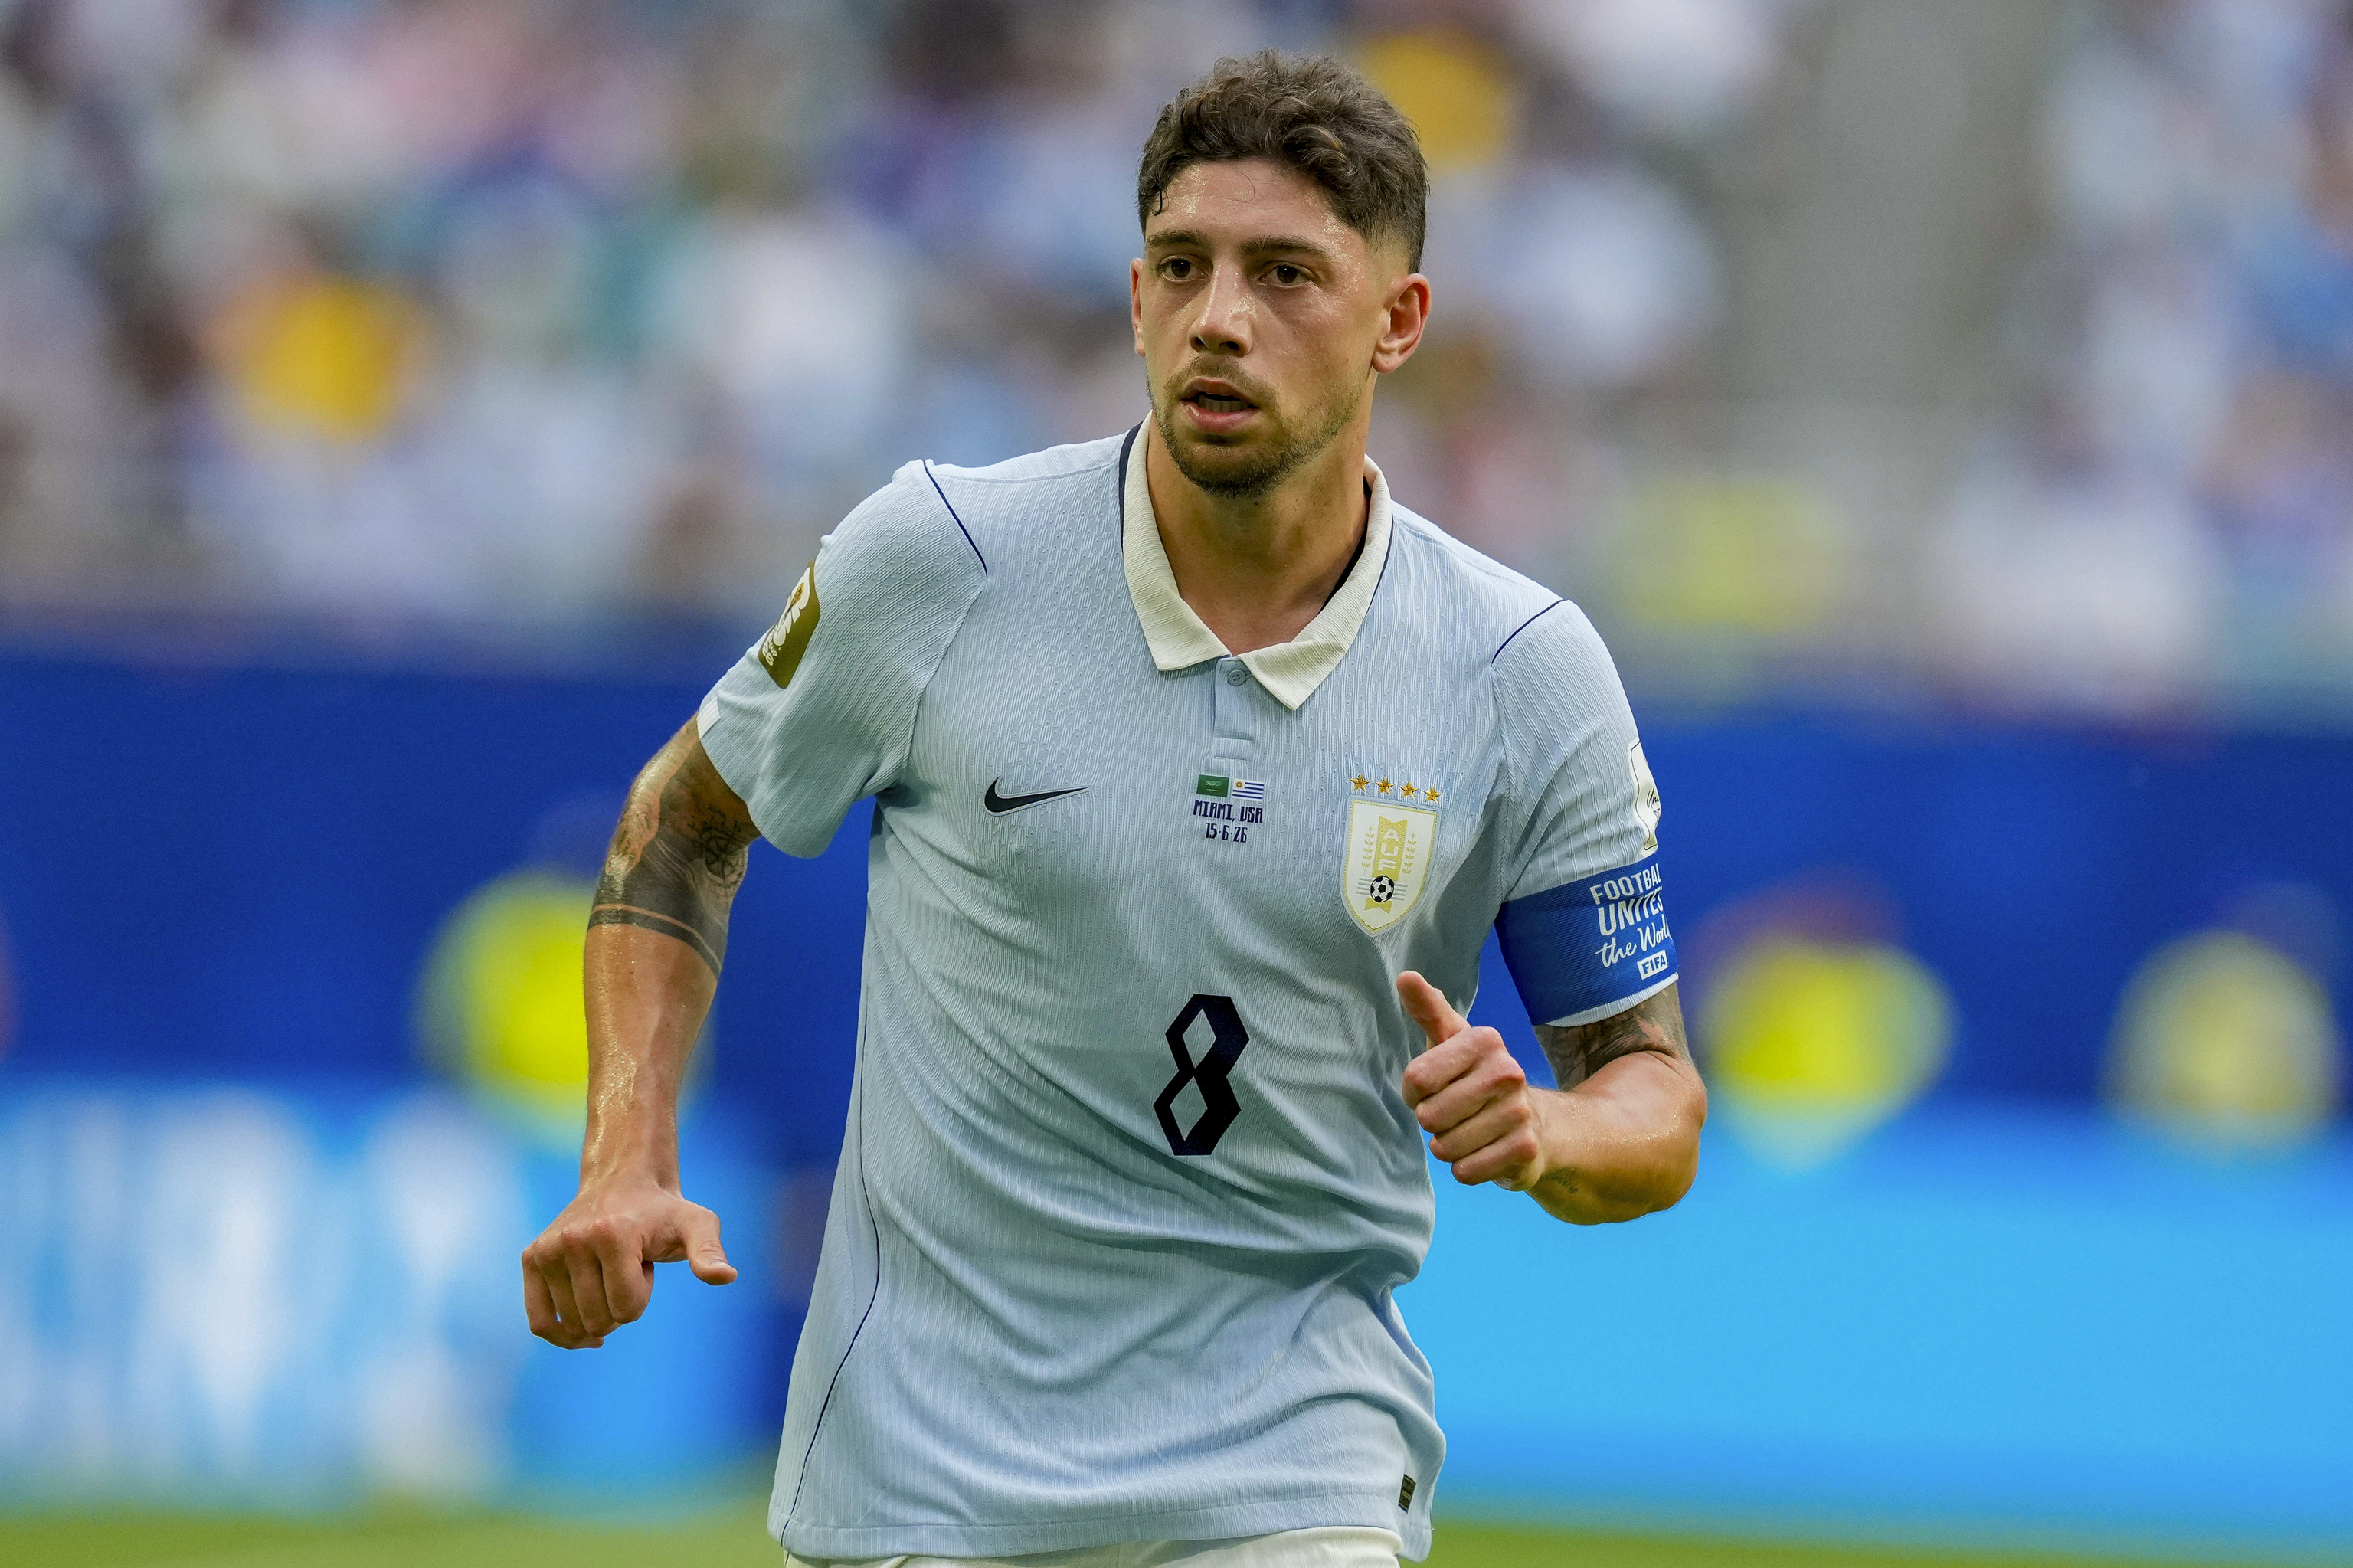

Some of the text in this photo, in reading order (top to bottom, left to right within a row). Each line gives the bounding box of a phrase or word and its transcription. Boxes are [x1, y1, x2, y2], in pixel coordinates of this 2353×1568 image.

[1193, 800, 1263, 823] MIAMI, USA
[1378, 828, 1400, 871] AUF
[1589, 863, 1661, 905] FOOTBAL
[1595, 937, 1637, 967] the
[1641, 954, 1667, 975] FIFA
[1153, 994, 1250, 1156] 8
